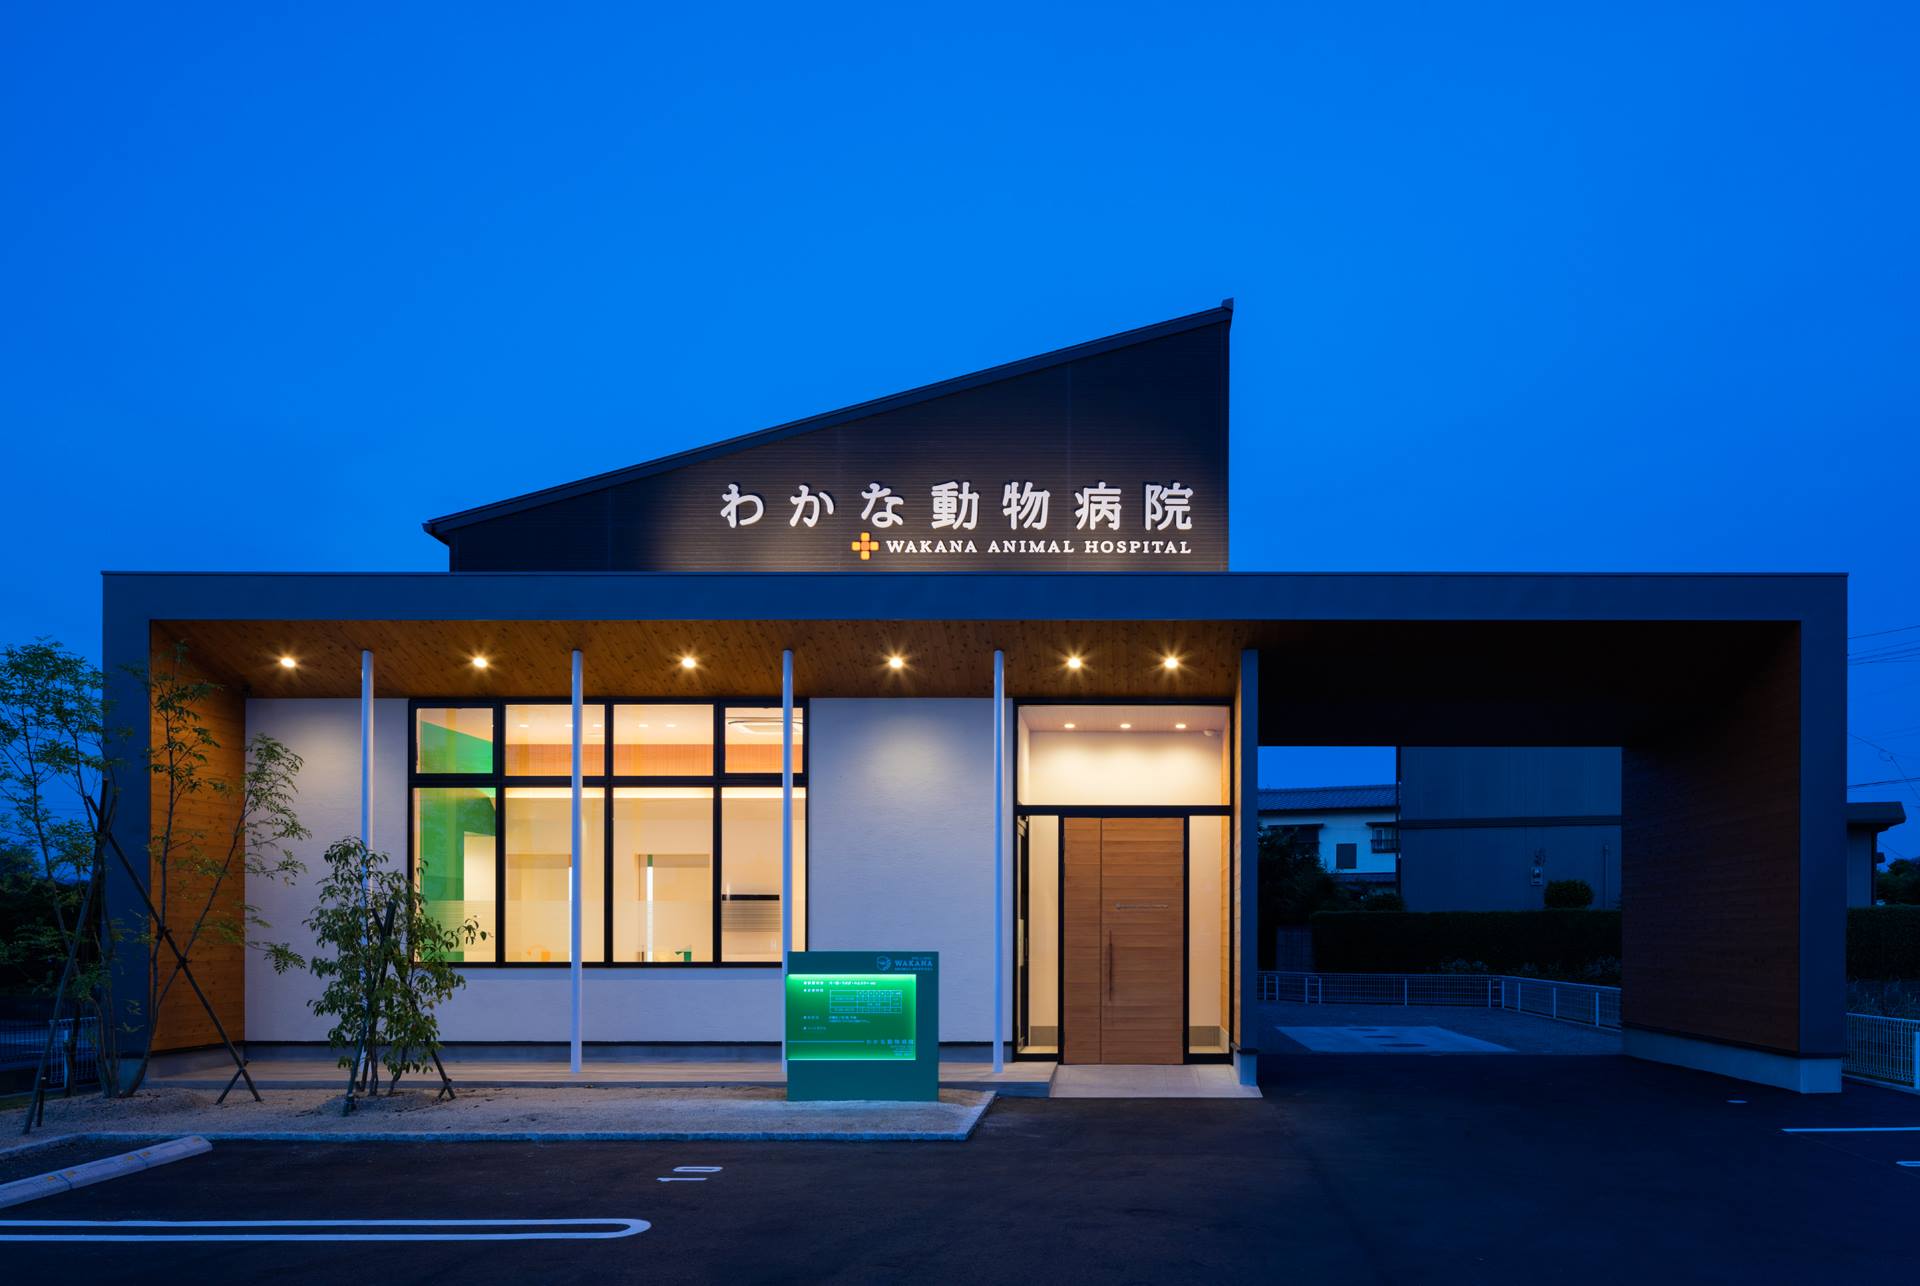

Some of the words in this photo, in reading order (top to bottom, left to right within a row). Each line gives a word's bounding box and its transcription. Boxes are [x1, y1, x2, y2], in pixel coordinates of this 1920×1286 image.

[720, 481, 1193, 531] わかな動物病院
[886, 540, 977, 554] WAKANA
[987, 540, 1075, 554] ANIMAL
[1084, 540, 1192, 554] HOSPITAL
